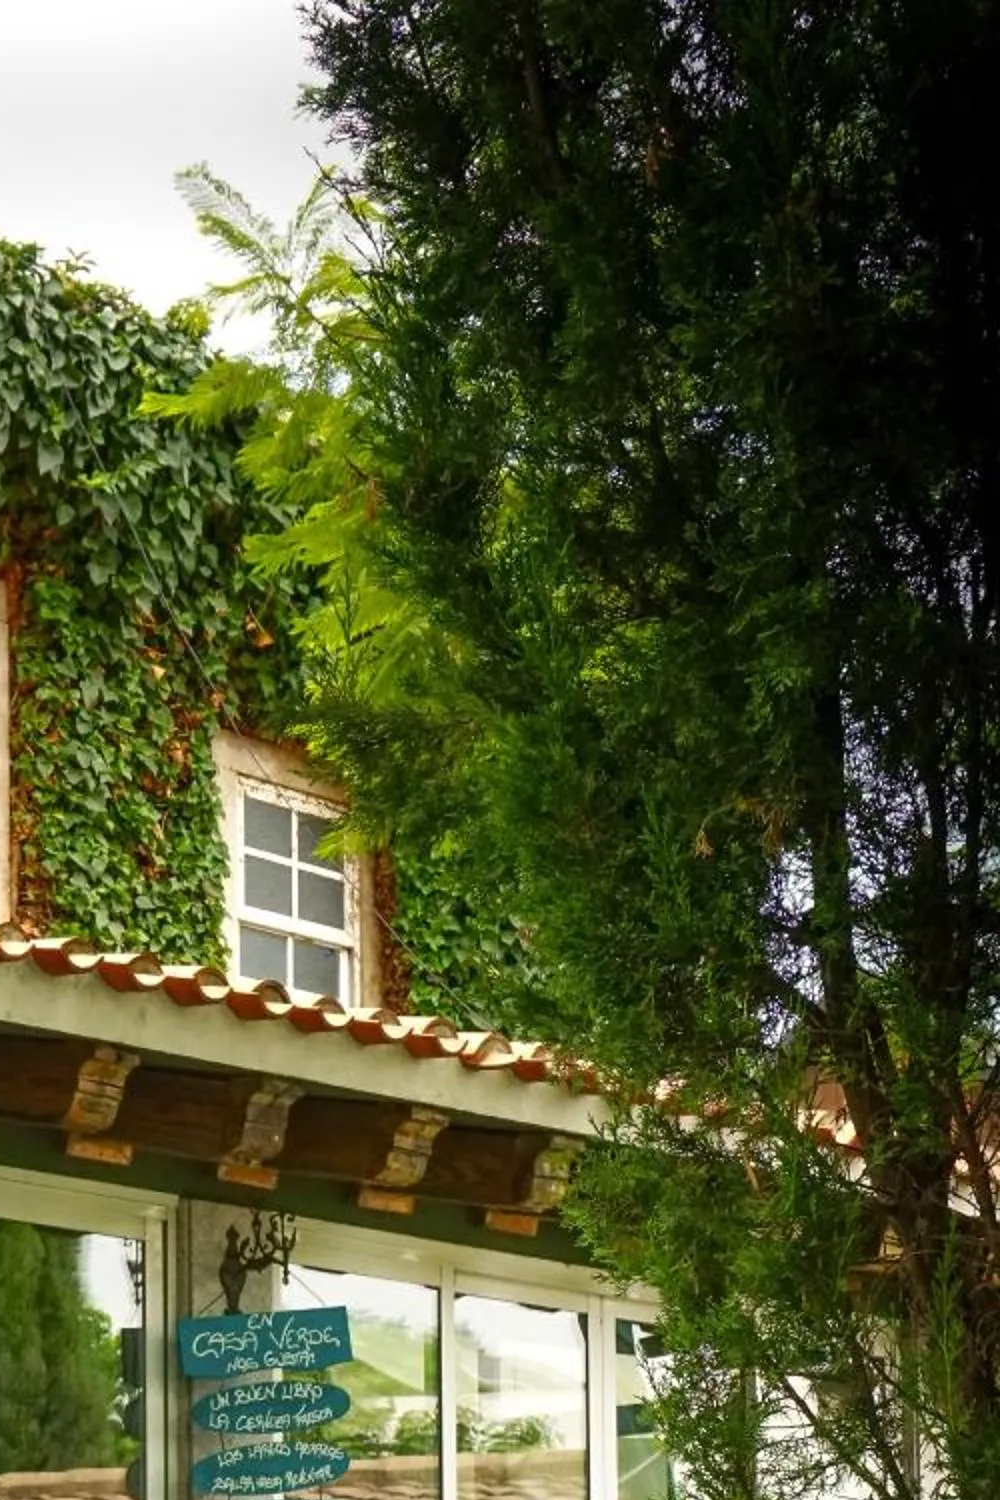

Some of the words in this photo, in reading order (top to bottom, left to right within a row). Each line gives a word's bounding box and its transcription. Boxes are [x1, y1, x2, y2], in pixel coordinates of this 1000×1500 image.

[247, 1312, 275, 1330] EN
[192, 1331, 258, 1359] CASA
[226, 1356, 259, 1373] NOS
[209, 1392, 230, 1411] UN
[234, 1382, 279, 1405] BUEN
[281, 1382, 324, 1404] LIBRO
[208, 1411, 230, 1431] LA
[216, 1448, 244, 1467] LOS
